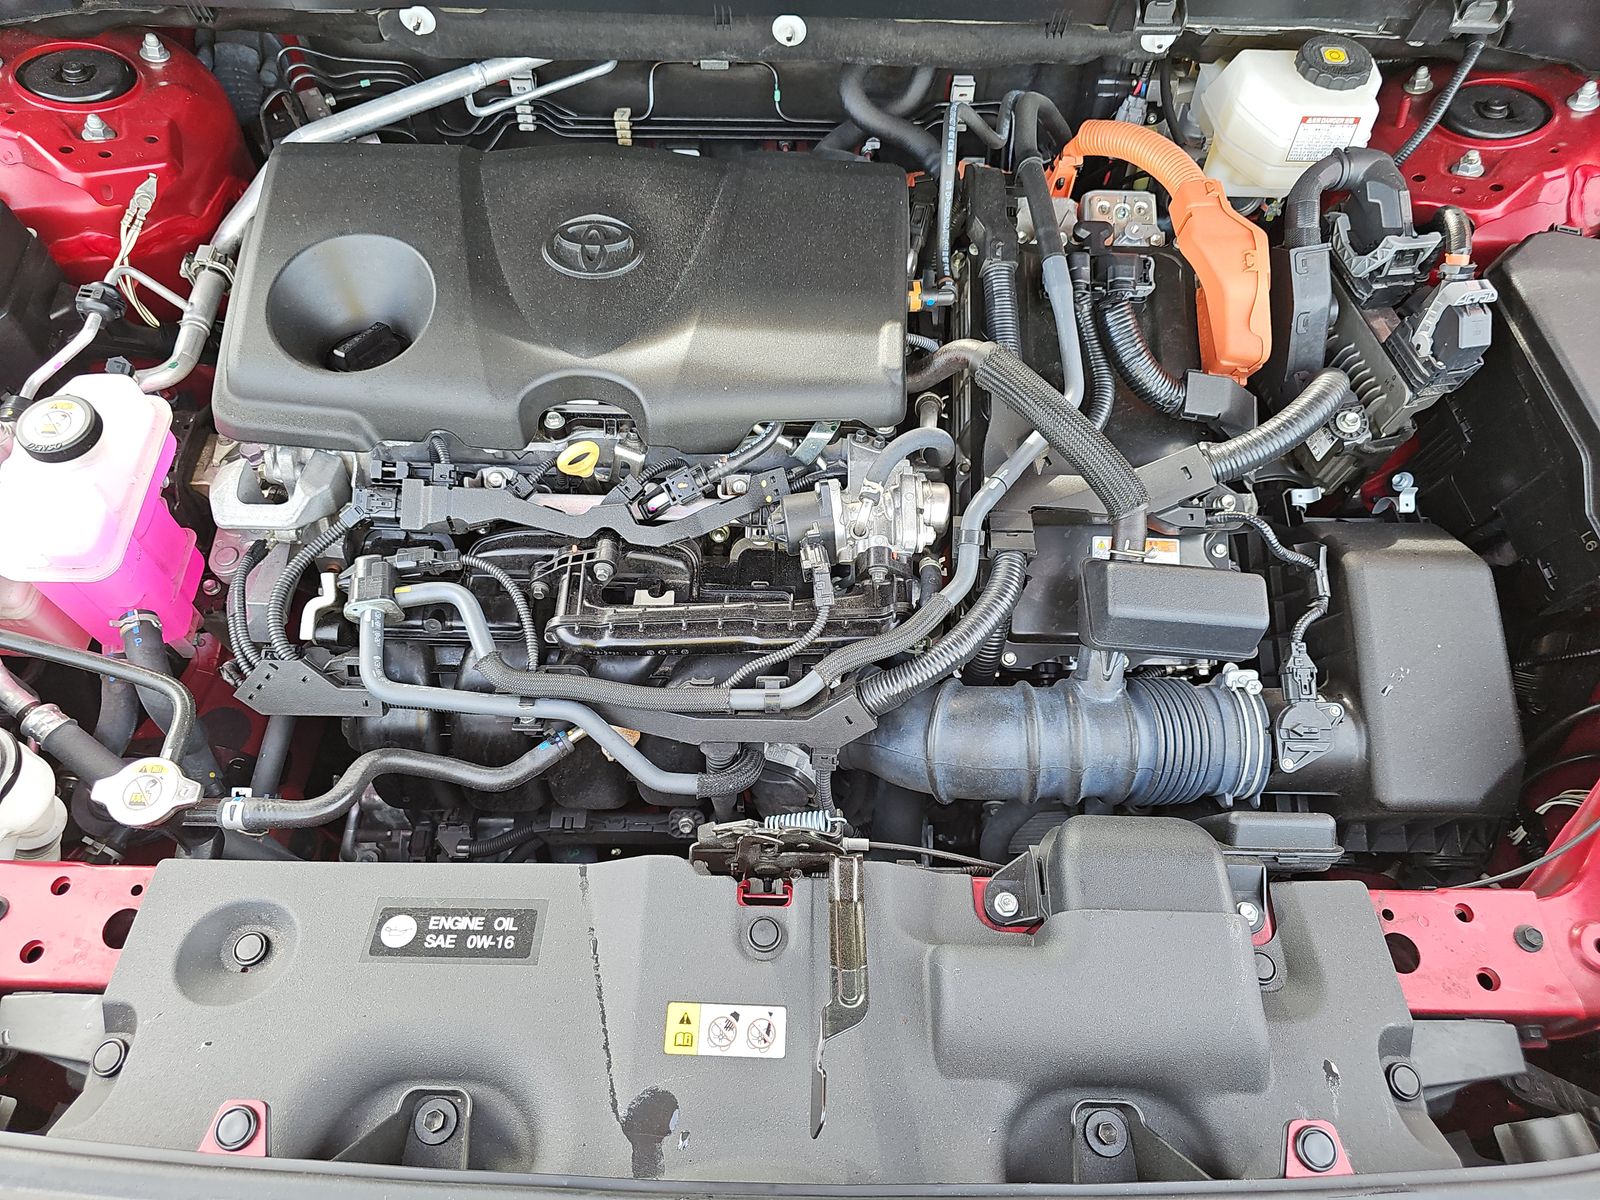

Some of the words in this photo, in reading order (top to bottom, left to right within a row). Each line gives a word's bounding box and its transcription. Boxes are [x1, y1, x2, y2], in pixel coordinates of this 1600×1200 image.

[26, 443, 63, 452] DENSO
[428, 916, 485, 931] ENGINE
[493, 916, 518, 931] OIL
[424, 934, 457, 949] SAE
[466, 935, 515, 949] 0W-16
